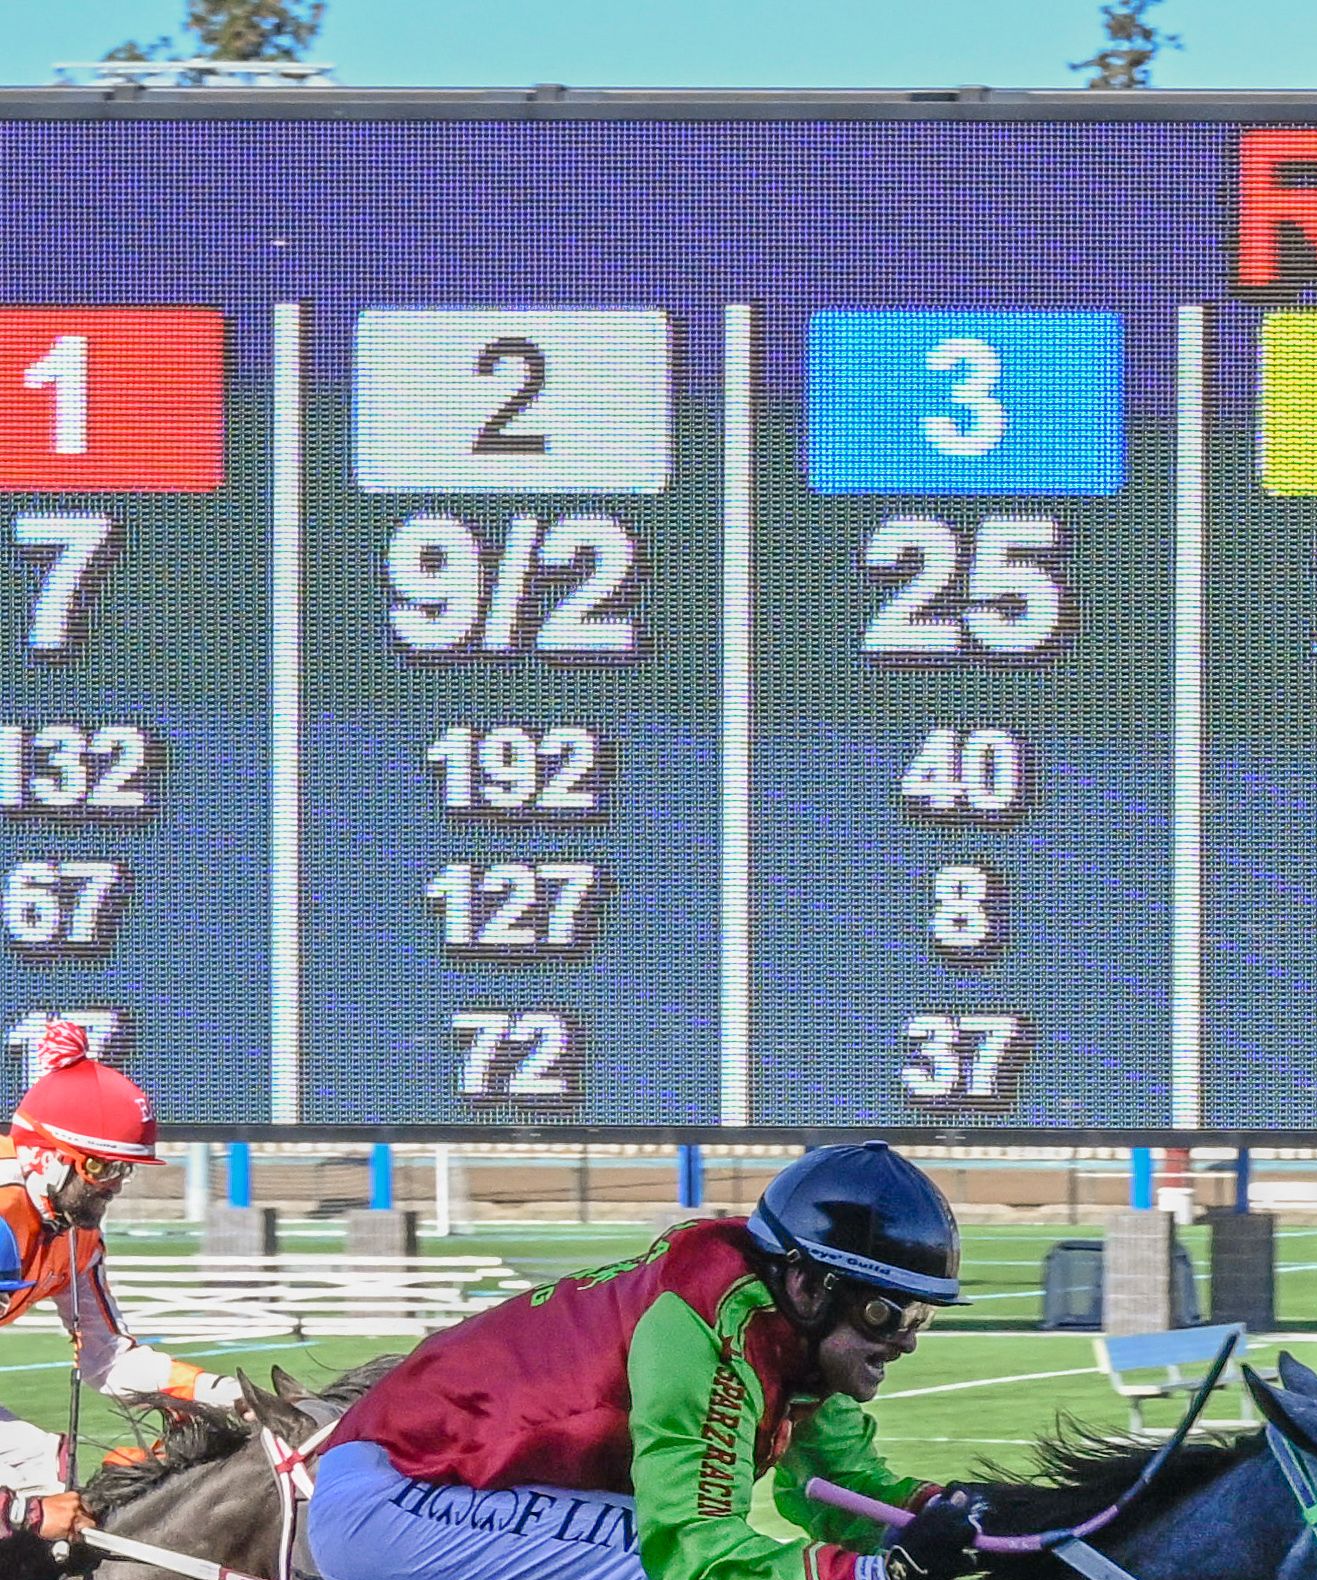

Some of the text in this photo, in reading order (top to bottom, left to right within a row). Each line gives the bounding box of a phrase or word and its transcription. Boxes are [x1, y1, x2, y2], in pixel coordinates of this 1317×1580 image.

[23, 334, 89, 456] 1
[469, 337, 550, 456] 2
[924, 337, 1007, 458] 3
[12, 512, 113, 651] 7
[386, 511, 638, 654] 9/2
[863, 515, 1066, 657] 25
[0, 725, 148, 809] 132
[425, 727, 596, 811] 192
[900, 730, 1022, 812] 40
[2, 861, 123, 944] 67
[425, 864, 602, 947] 127
[932, 866, 989, 948] 8
[451, 1013, 568, 1097] 72
[900, 1016, 1022, 1099] 37
